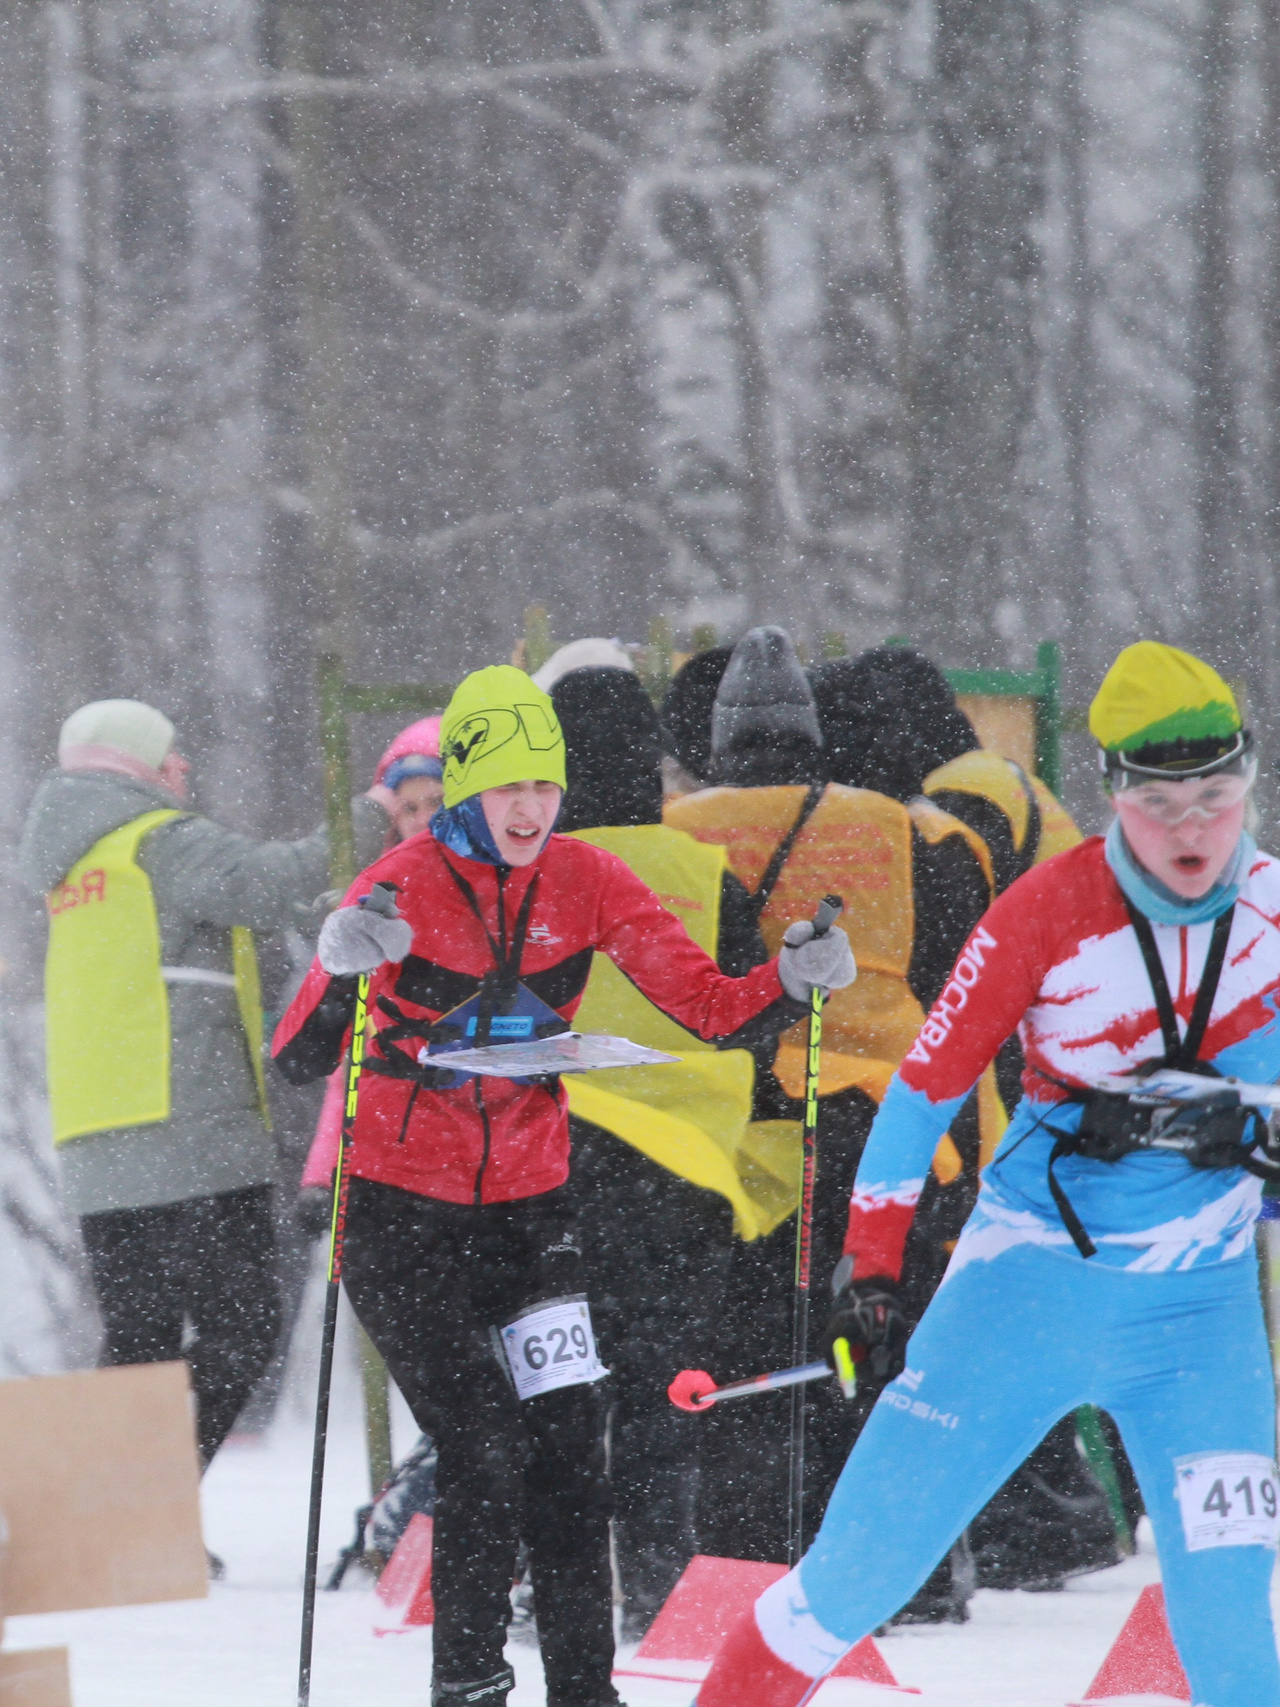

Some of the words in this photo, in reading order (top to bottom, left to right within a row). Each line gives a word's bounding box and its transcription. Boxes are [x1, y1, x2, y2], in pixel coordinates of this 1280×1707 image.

[906, 926, 998, 1064] МОСКВА
[523, 1324, 588, 1370] 629
[1203, 1476, 1277, 1518] 419
[466, 1679, 512, 1702] SPINE
